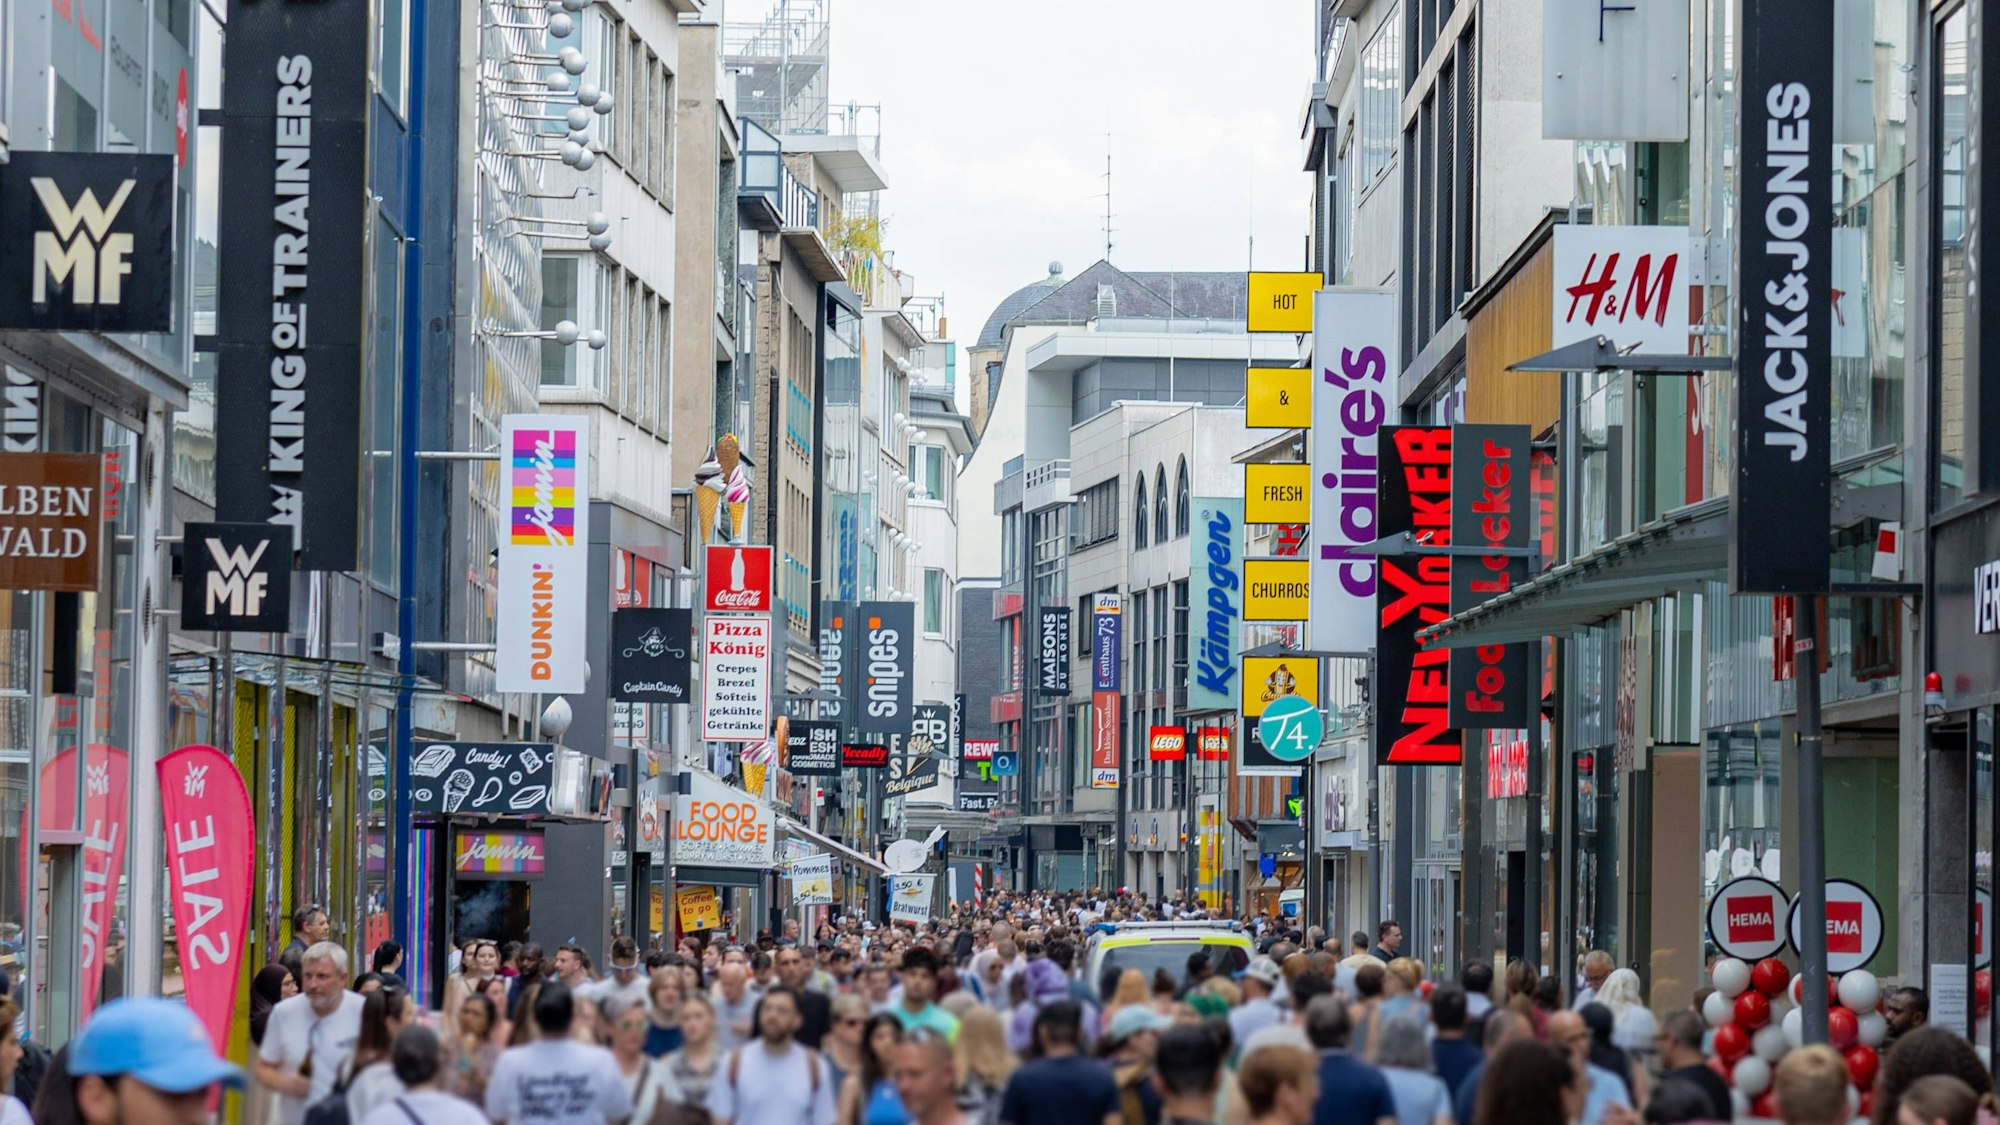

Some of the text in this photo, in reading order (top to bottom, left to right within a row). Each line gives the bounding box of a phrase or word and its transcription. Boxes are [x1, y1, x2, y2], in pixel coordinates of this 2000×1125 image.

[30, 177, 137, 303] WMF
[269, 54, 313, 472] KING OF TRAINERS
[1764, 82, 1811, 462] JACK&JONES
[1566, 252, 1678, 328] H&M
[1273, 294, 1298, 310] HOT
[1279, 390, 1289, 405] &
[1321, 345, 1386, 598] claire's
[524, 429, 569, 546] jamin
[1264, 486, 1303, 502] FRESH
[205, 537, 271, 617] WMF
[1466, 438, 1511, 713] Foo Locker
[714, 589, 762, 607] Coca-Cola
[1252, 582, 1309, 599] CHURROS
[1974, 559, 2000, 634] VER
[1099, 596, 1118, 607] dm
[1197, 510, 1239, 696] Kämpgen
[713, 622, 762, 637] Pizza
[1098, 617, 1115, 636] 73
[709, 641, 765, 658] König
[1043, 613, 1057, 689] MAISONS
[716, 664, 758, 674] Crepes
[867, 629, 905, 718] snipes
[623, 681, 683, 697] Captain Candy
[717, 679, 756, 687] Brezel
[1060, 672, 1067, 689] DU
[715, 692, 758, 701] Softeis
[709, 703, 763, 717] gekühlte
[707, 720, 764, 730] Getränke
[809, 728, 837, 742] SH
[1153, 736, 1182, 749] LEGO
[465, 747, 512, 771] Candy!
[791, 761, 836, 769] COSMETICS
[885, 773, 935, 794] Belgique
[1097, 771, 1116, 781] dm
[690, 801, 757, 823] FOOD
[678, 819, 768, 844] LOUNGE
[455, 837, 545, 871] jamin
[792, 864, 830, 877] Pommes
[681, 894, 713, 905] Coffee
[683, 904, 711, 916] to go
[893, 901, 929, 916] Bratwurst
[1729, 912, 1773, 928] HEMA
[1826, 920, 1861, 935] EMA
